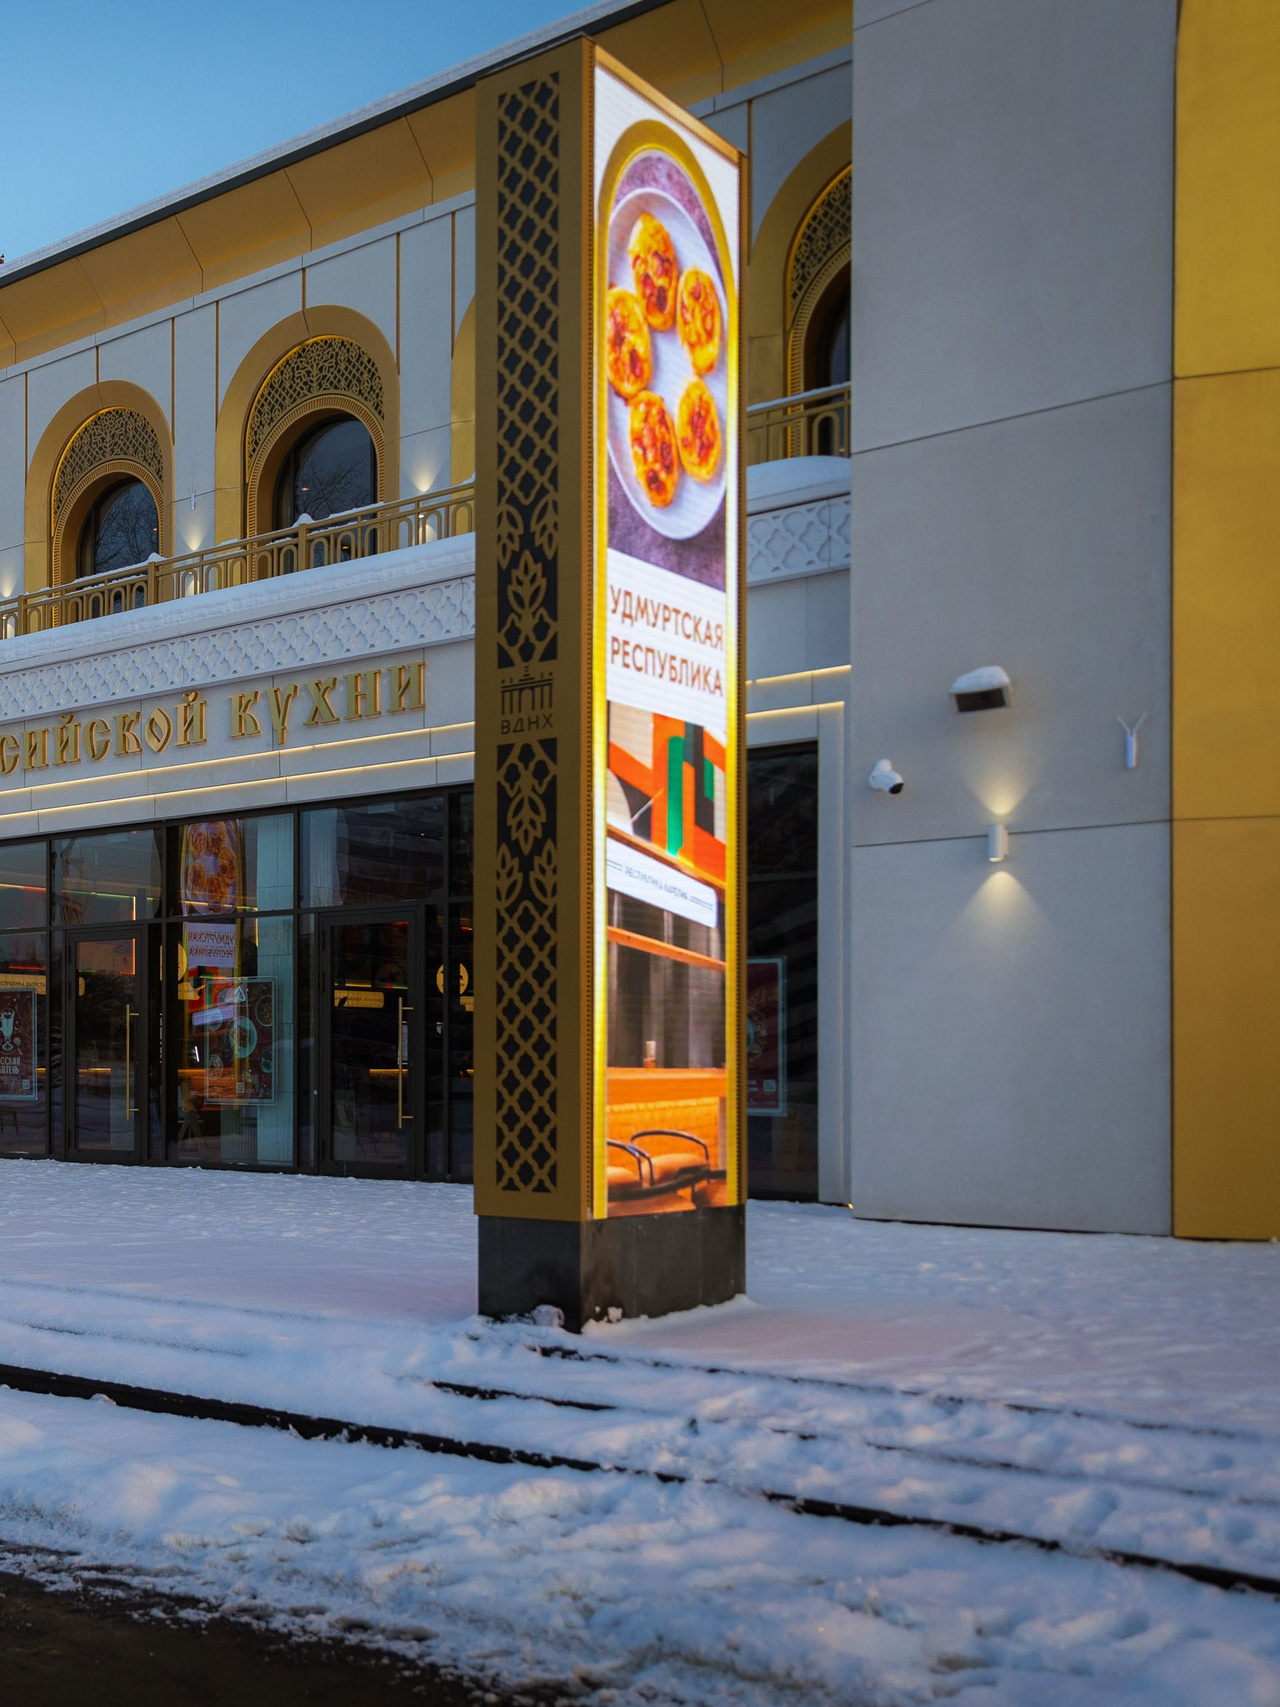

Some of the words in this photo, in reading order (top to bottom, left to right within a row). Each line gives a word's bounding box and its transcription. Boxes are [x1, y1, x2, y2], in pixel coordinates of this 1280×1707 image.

[609, 585, 724, 652] УДМУРТСКАЯ
[610, 636, 724, 697] РЕСПУБЛИКА
[229, 661, 426, 745] КУХНИ
[500, 713, 553, 735] ВДНХ
